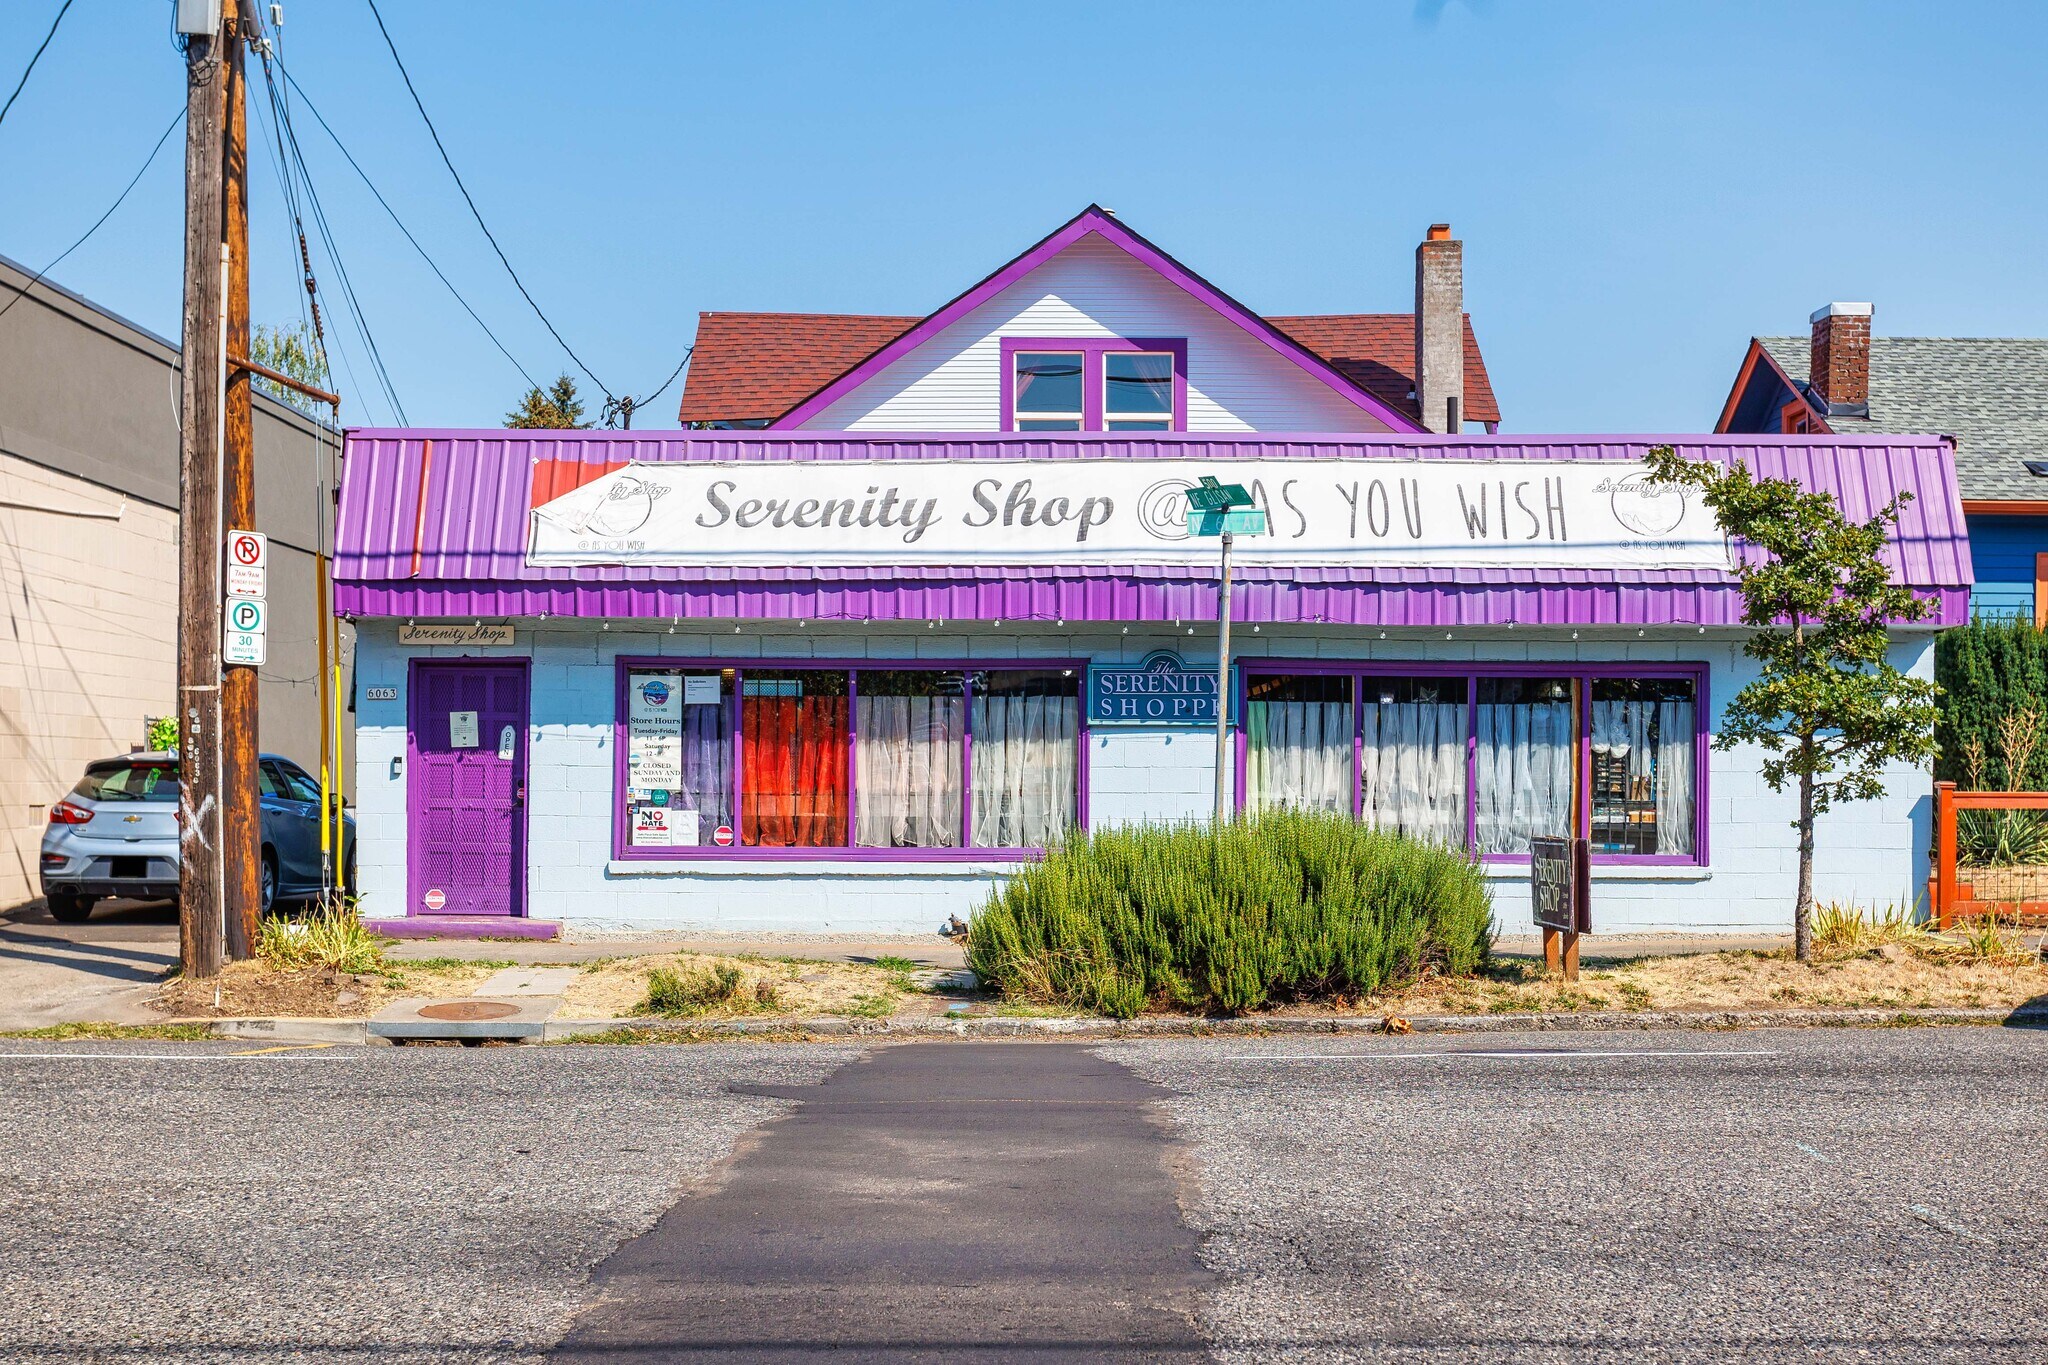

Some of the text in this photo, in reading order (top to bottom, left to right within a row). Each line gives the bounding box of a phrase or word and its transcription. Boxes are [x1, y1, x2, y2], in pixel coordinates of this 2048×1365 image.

[631, 480, 671, 500] Shop
[1592, 477, 1661, 498] Serenity
[1190, 492, 1204, 508] NE
[1205, 488, 1235, 505] GLISAN
[695, 476, 1567, 543] Serenity Shop @ AS YOU WISH
[1191, 515, 1210, 532] NE
[1243, 515, 1260, 531] AV
[592, 540, 600, 550] AS
[603, 540, 624, 551] YOU
[627, 540, 646, 550] WISH
[1645, 540, 1664, 551] YOU
[1668, 540, 1686, 550] WISH
[238, 635, 253, 646] 30
[403, 626, 508, 644] Serenity Shop
[232, 646, 258, 654] MINUTES
[1151, 660, 1176, 675] The
[1100, 674, 1219, 695] SERENITY
[368, 689, 396, 698] 6063
[631, 717, 681, 725] Store Hours
[503, 731, 512, 756] OPEN
[1540, 885, 1560, 913] SHOP
